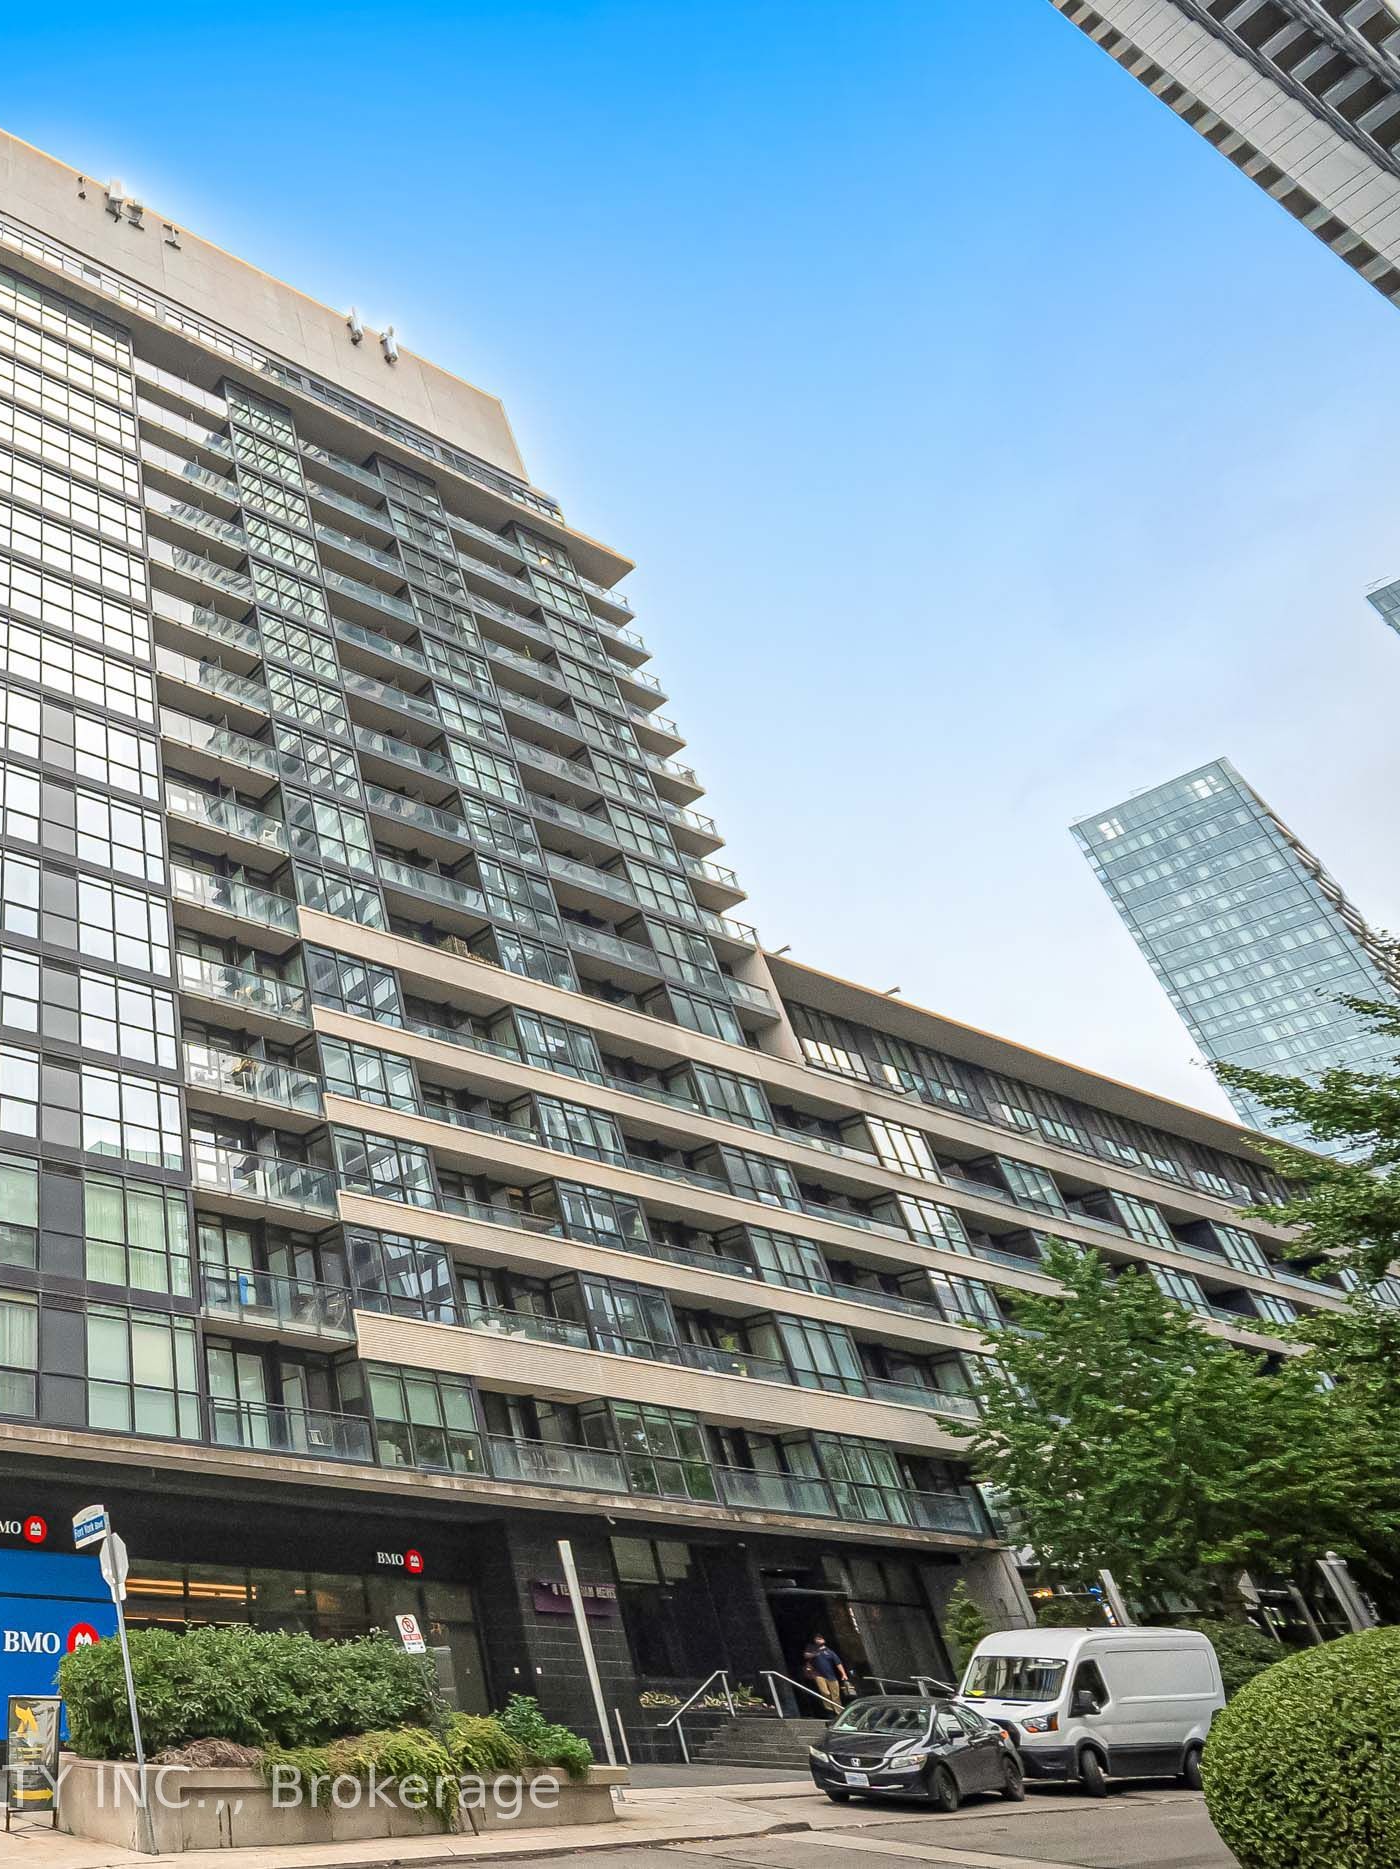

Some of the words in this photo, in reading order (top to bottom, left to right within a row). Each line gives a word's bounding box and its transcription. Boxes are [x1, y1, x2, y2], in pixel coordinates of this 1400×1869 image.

[74, 1525, 85, 1541] Fort
[83, 1521, 95, 1534] York
[377, 1551, 405, 1566] BMO
[3, 1630, 61, 1654] BMO
